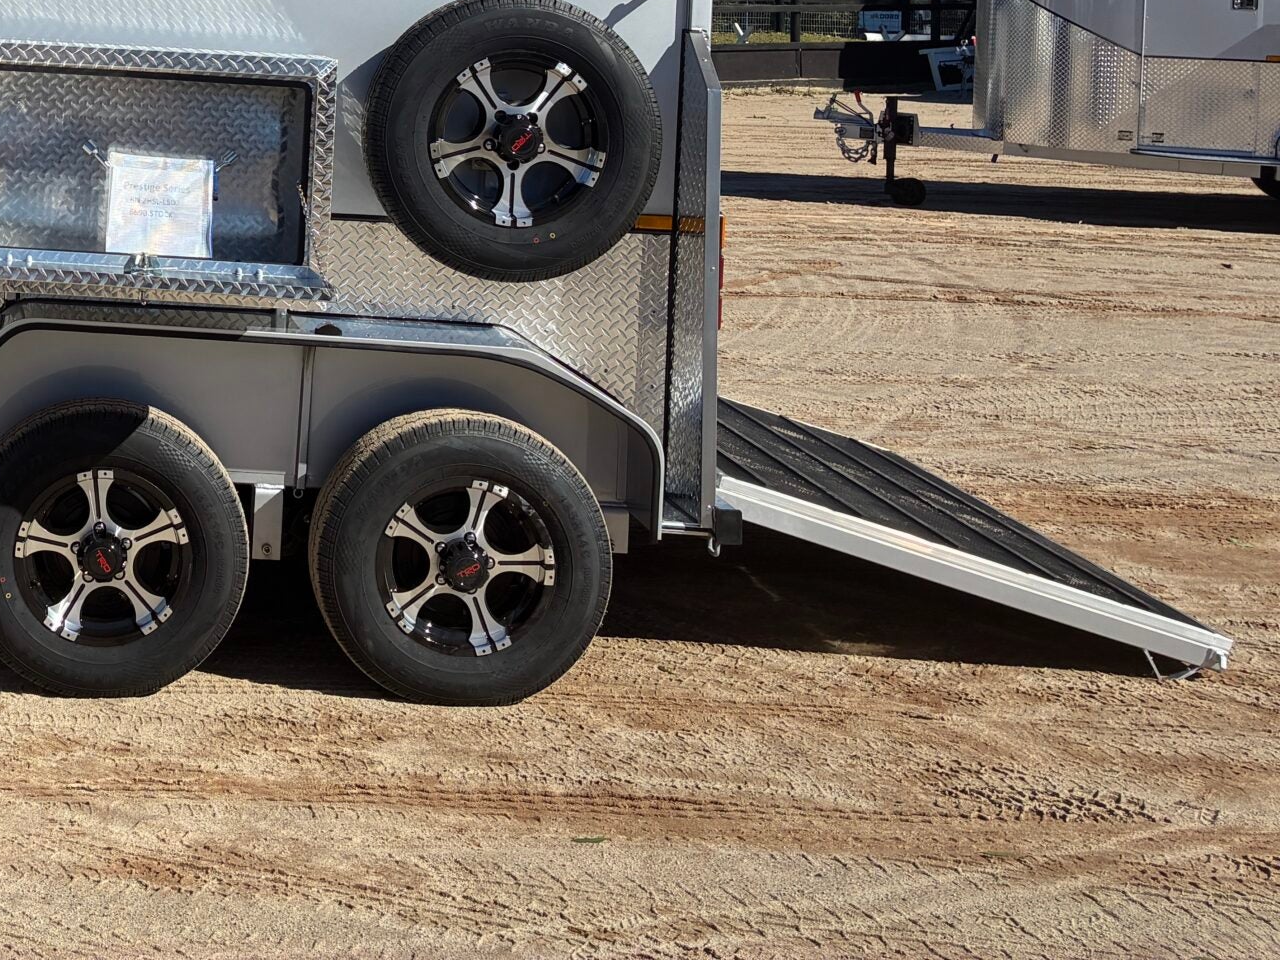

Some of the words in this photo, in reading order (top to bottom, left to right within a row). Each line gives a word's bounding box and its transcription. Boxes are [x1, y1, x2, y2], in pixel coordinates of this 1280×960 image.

[511, 130, 533, 152] TRD
[95, 549, 112, 573] TRD
[455, 562, 481, 578] TRD
